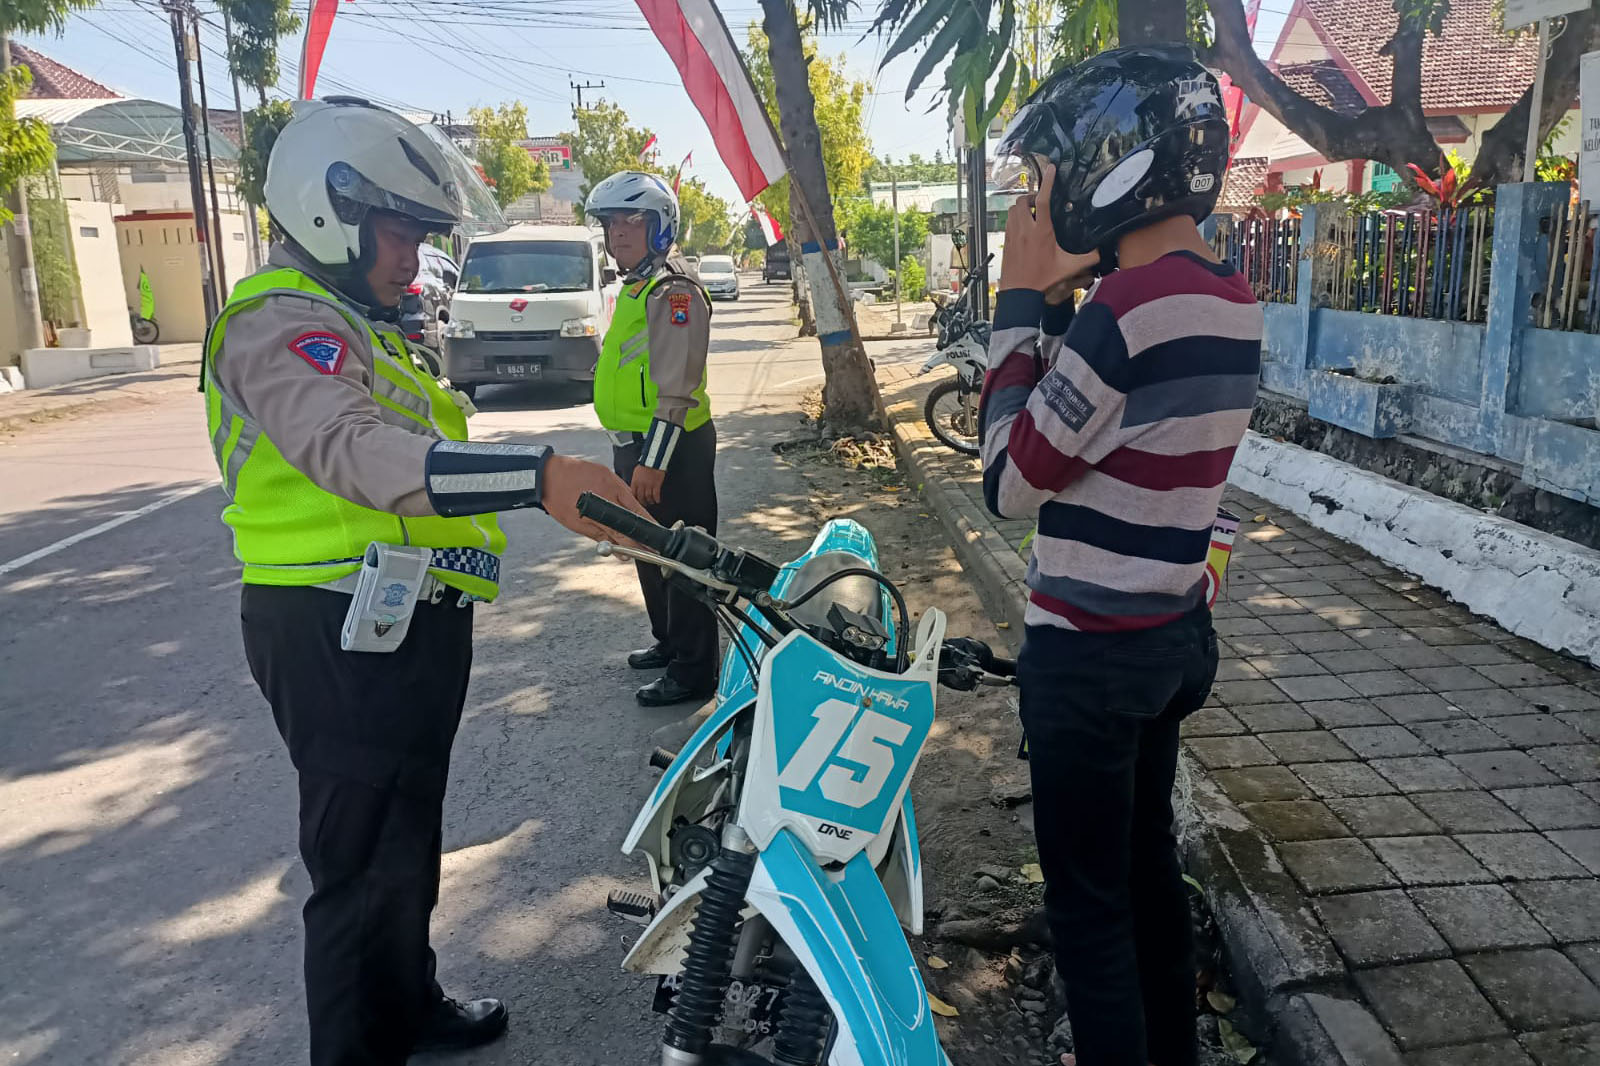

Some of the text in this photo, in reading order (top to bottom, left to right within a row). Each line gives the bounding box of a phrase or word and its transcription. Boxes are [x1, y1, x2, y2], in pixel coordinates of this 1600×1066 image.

[1194, 177, 1212, 189] DOT
[945, 349, 971, 359] POLISI
[778, 698, 912, 809] 15
[817, 823, 853, 841] ONE
